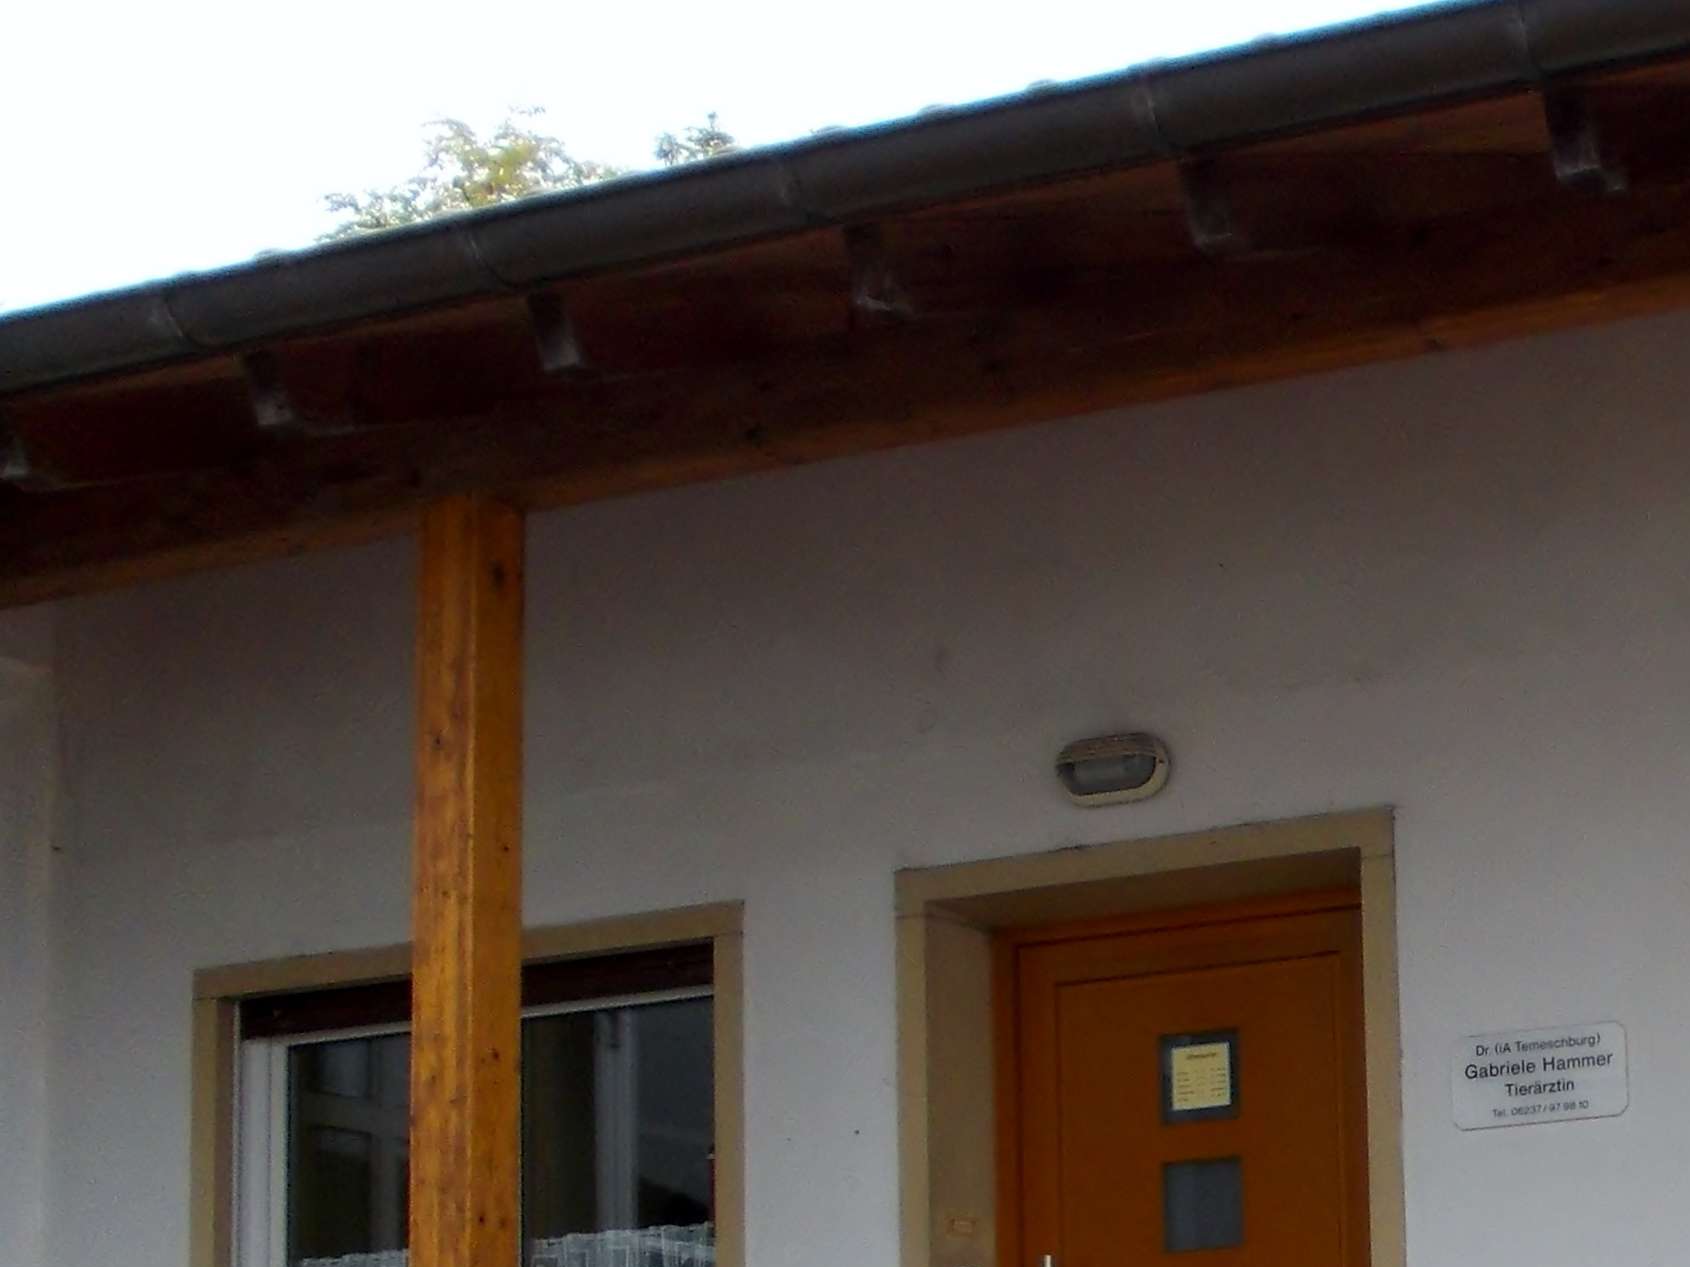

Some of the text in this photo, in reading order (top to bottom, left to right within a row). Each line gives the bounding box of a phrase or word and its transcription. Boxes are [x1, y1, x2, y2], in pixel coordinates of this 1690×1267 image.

[1464, 1054, 1613, 1080] Gabriele Hammer
[1505, 1079, 1575, 1097] Tierärztin
